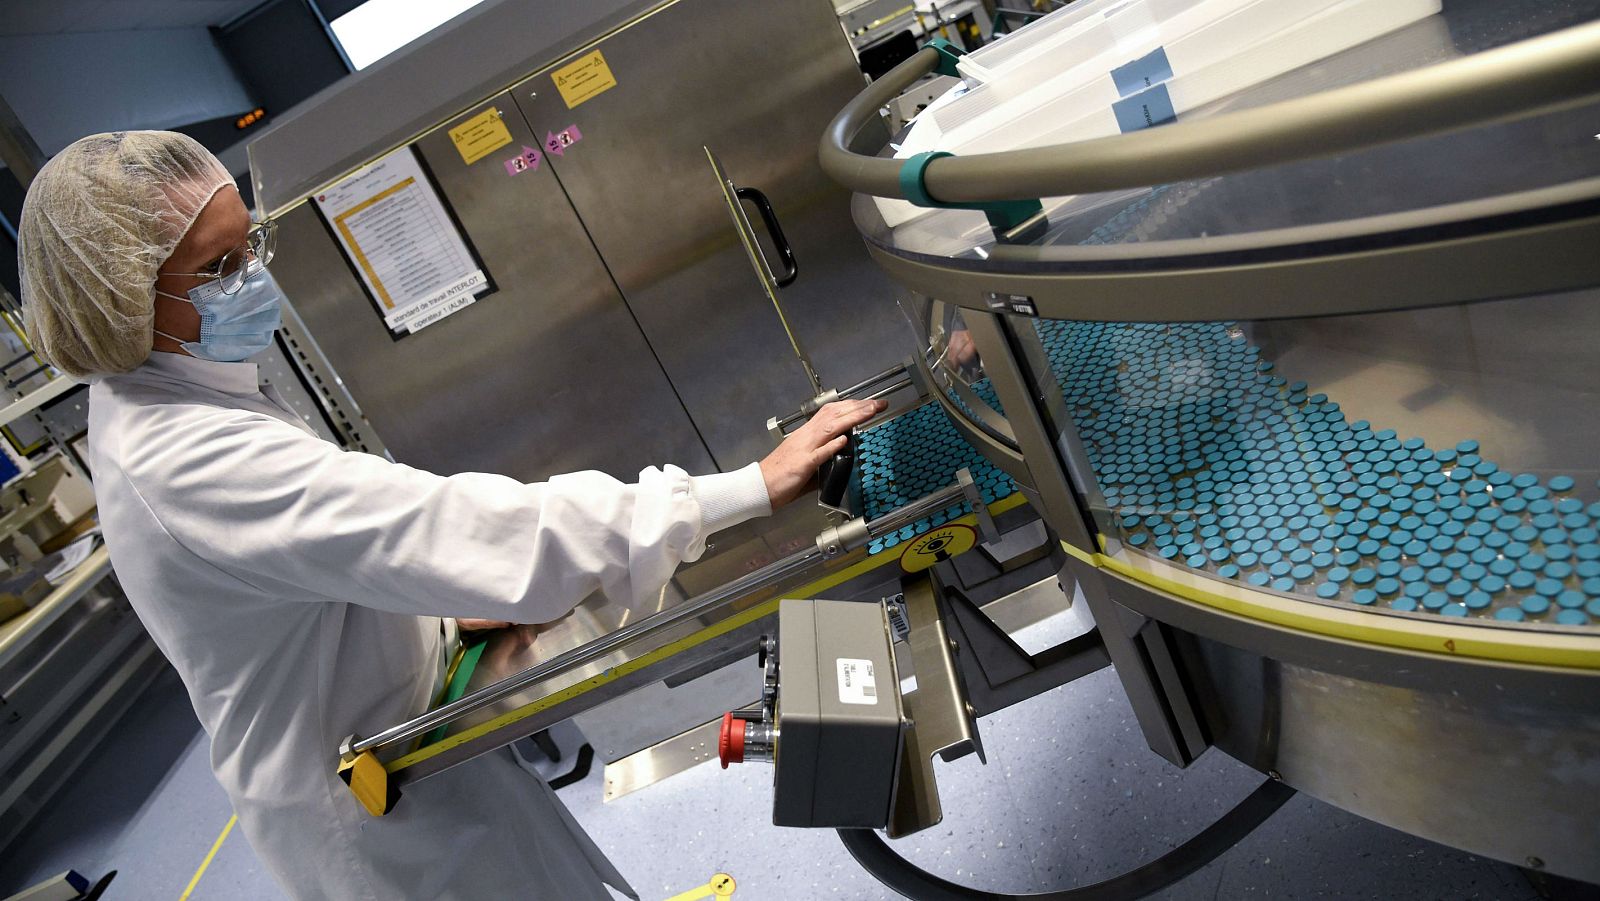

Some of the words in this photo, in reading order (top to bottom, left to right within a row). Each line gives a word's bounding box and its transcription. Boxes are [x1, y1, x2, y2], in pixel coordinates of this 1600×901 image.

[548, 140, 559, 151] 15
[526, 153, 536, 163] 15
[393, 305, 421, 323] standard
[420, 302, 429, 311] de
[429, 293, 447, 306] travail
[446, 276, 479, 296] INTERLOT
